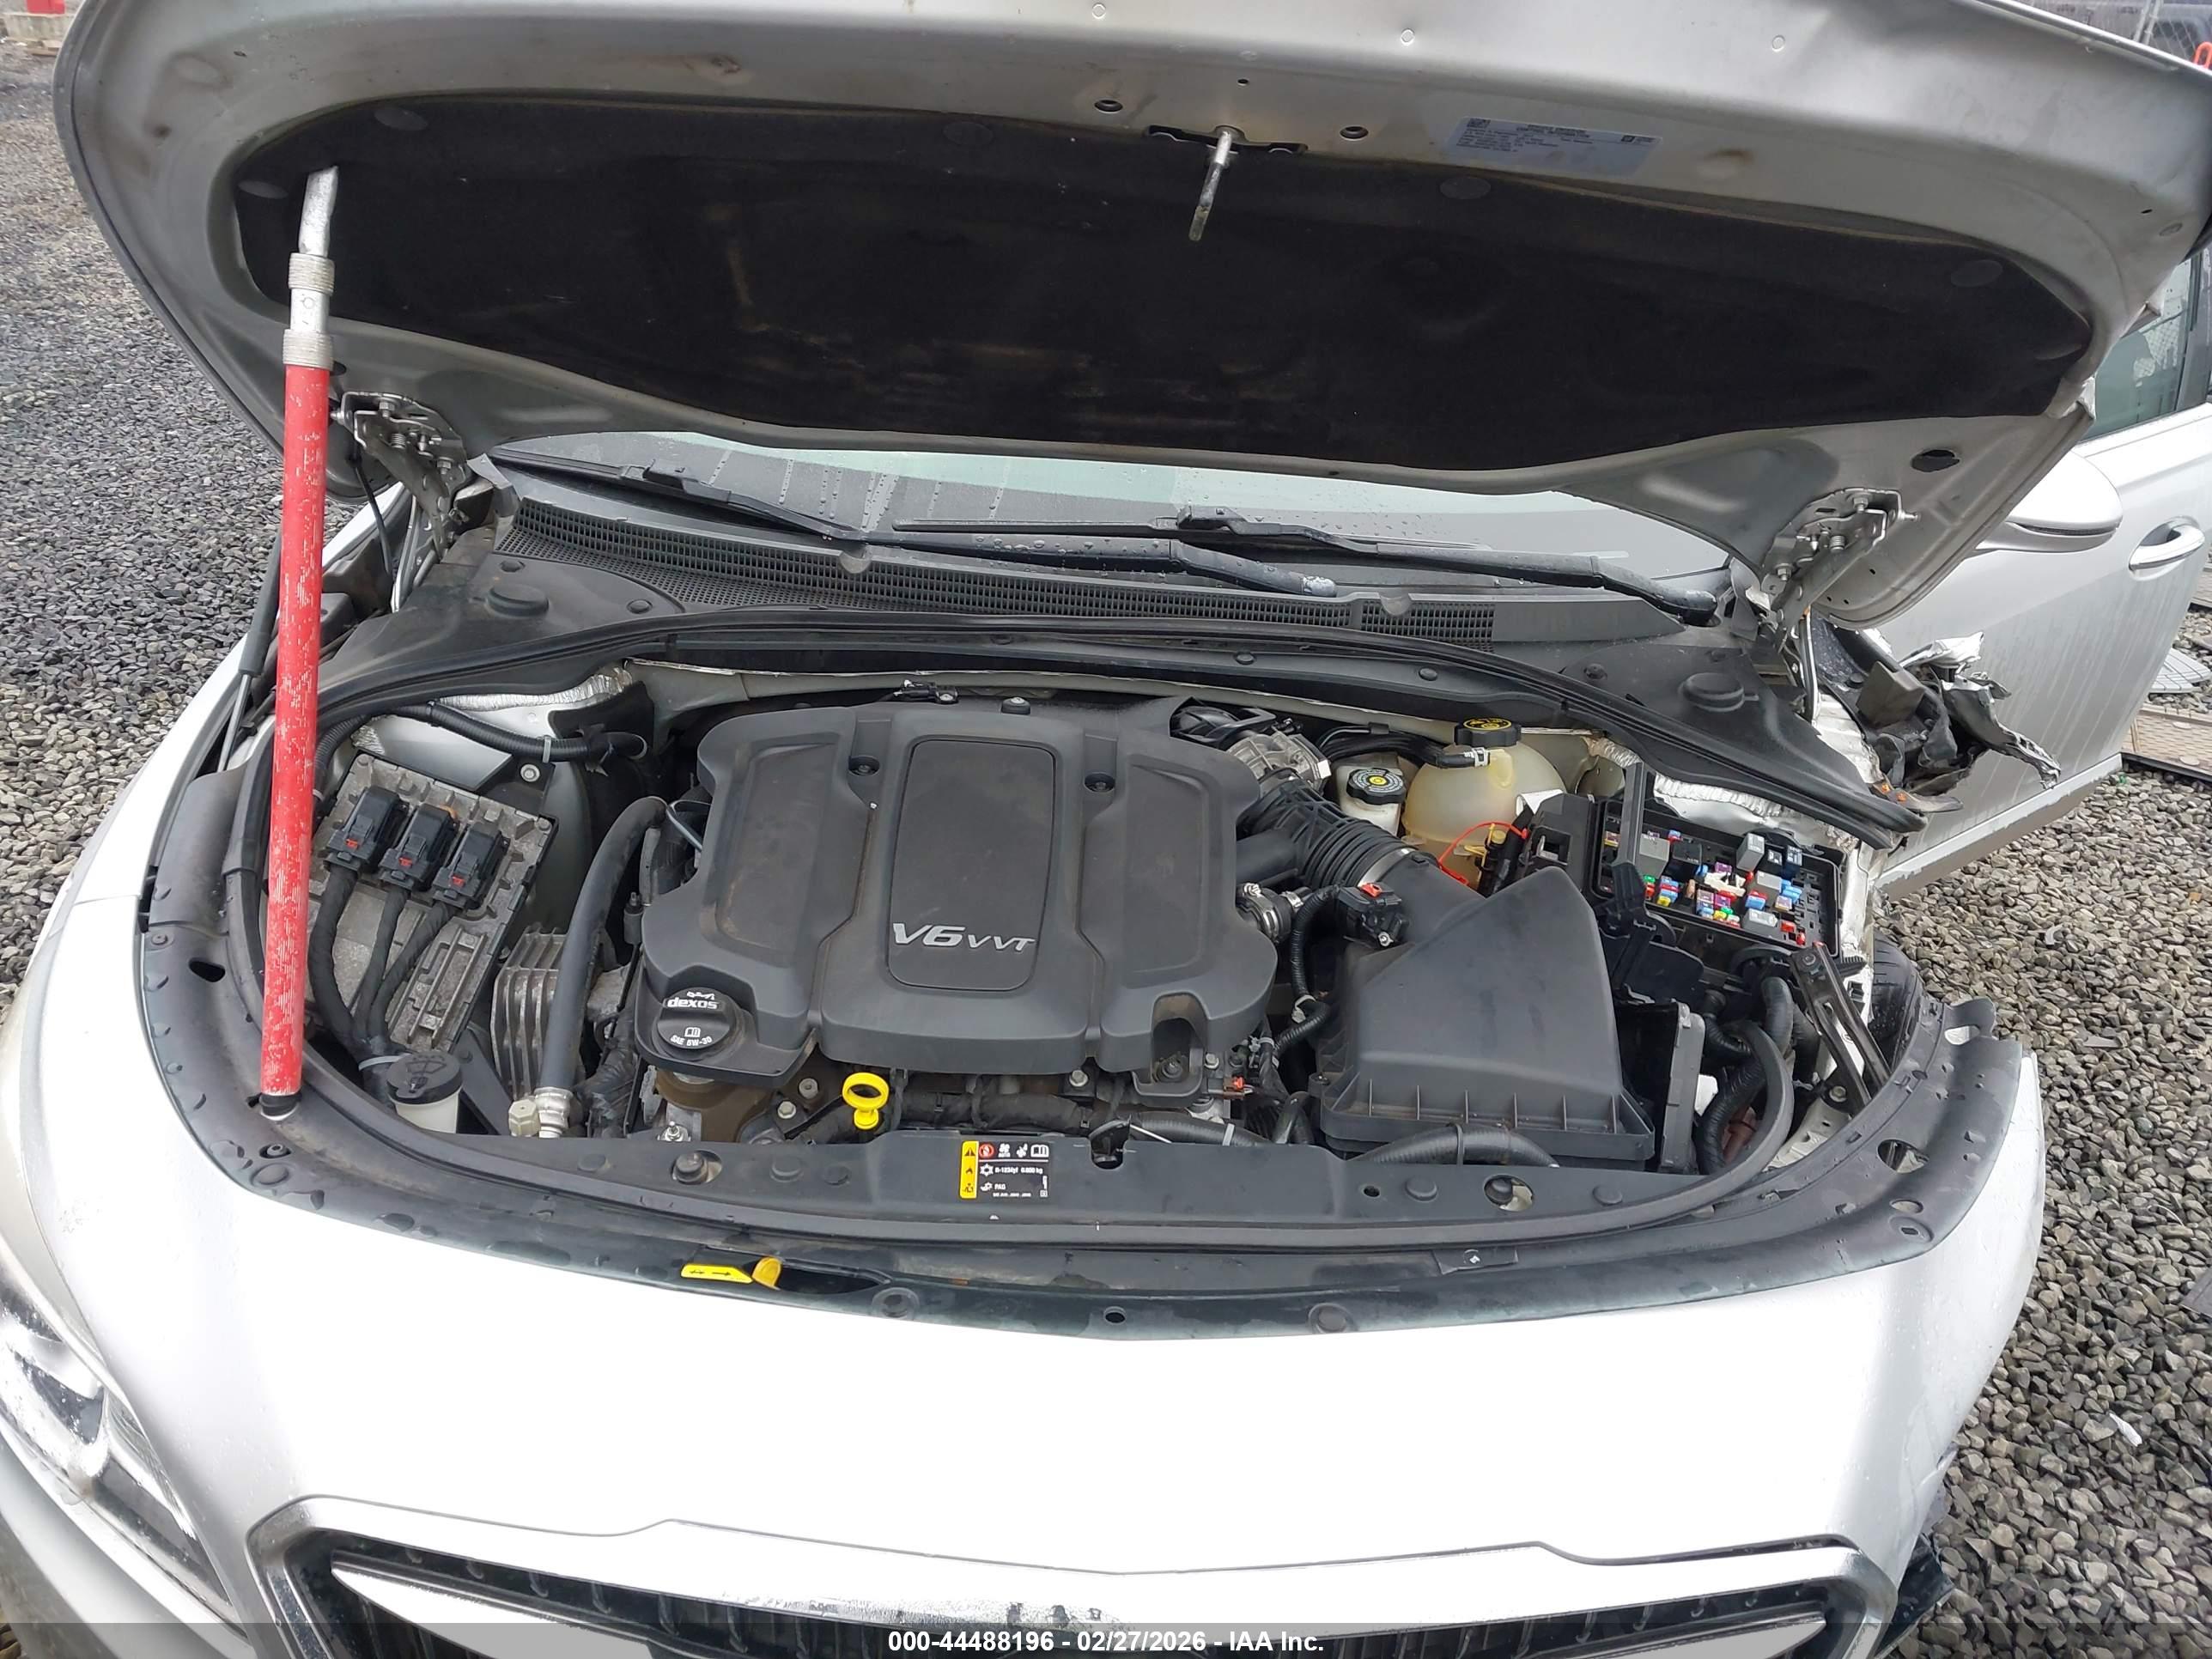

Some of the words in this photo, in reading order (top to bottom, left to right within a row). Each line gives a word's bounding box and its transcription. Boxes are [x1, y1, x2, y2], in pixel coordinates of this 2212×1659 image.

[893, 923, 965, 945] V6
[969, 935, 1035, 951] VVT
[667, 997, 718, 1009] dexos
[671, 1035, 685, 1045] SAE
[687, 1036, 712, 1046] 5W-30
